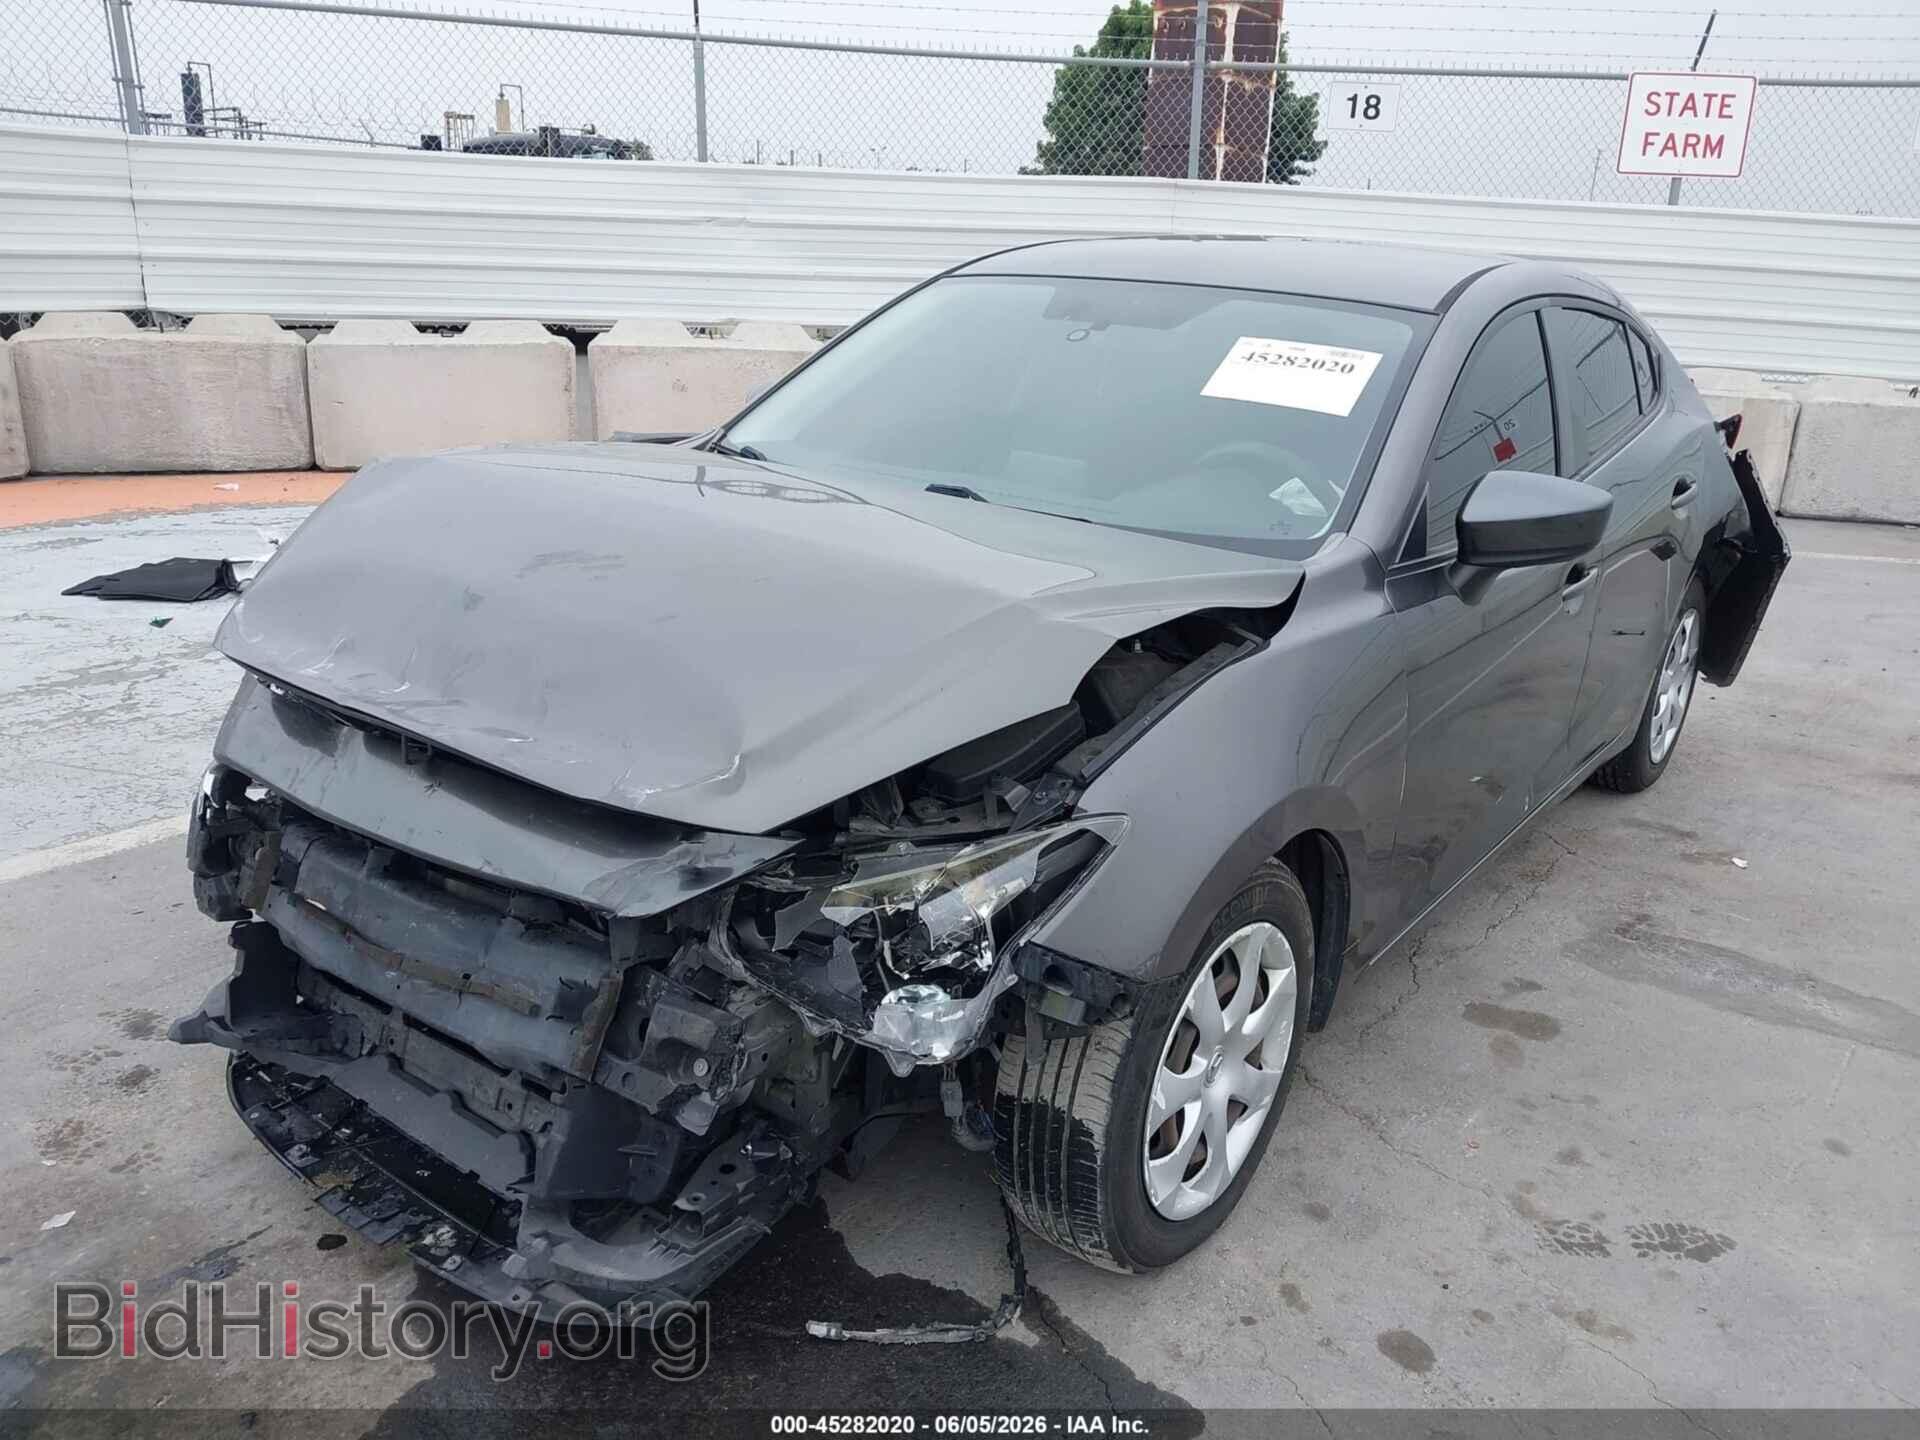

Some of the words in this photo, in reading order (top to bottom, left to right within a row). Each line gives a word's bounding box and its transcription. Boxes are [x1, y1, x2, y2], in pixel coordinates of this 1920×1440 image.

[1346, 93, 1381, 121] 18
[1644, 91, 1736, 119] STATE
[1642, 131, 1725, 159] FARM
[1241, 351, 1355, 374] 45282020
